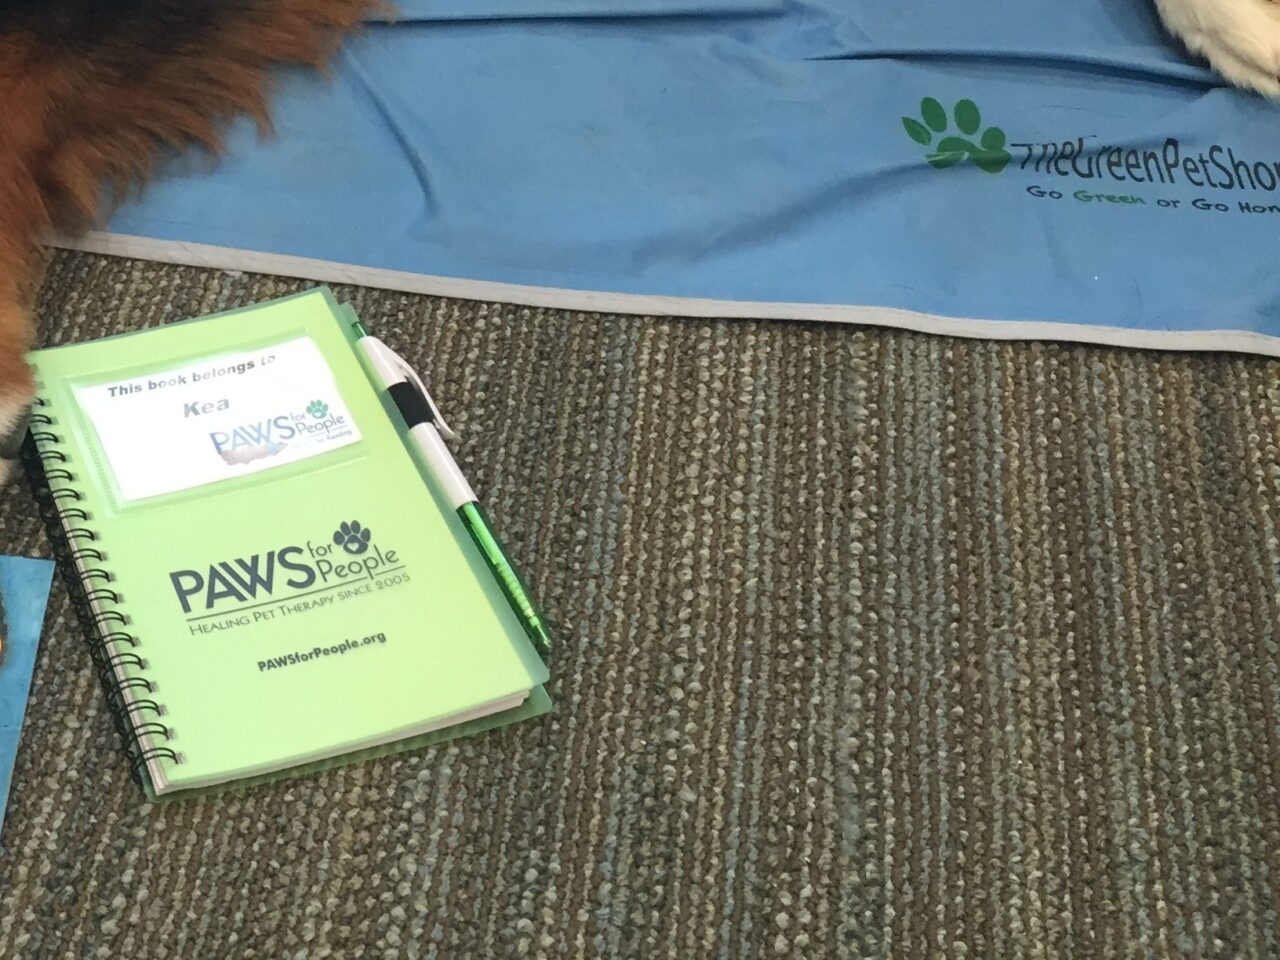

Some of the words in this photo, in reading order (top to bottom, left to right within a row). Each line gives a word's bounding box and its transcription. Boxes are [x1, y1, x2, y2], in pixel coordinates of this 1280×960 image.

[1010, 134, 1280, 192] TheGreenPetSho
[1026, 185, 1063, 200] Go
[1073, 189, 1146, 205] Green
[1157, 198, 1181, 208] or
[1192, 198, 1230, 212] Go
[107, 382, 143, 398] This
[148, 375, 187, 391] book
[192, 359, 256, 383] belongs
[260, 354, 276, 366] to
[183, 398, 230, 419] Kea
[294, 412, 346, 437] People
[209, 415, 296, 455] PAWS
[290, 411, 306, 422] for
[169, 546, 317, 614] PAWS
[306, 540, 334, 559] for
[315, 543, 400, 583] People
[189, 612, 251, 636] HEALING
[253, 609, 276, 623] PET
[278, 594, 336, 618] THERAPY
[377, 572, 411, 591] 2005
[258, 631, 387, 672] PAWSforPeople.org
